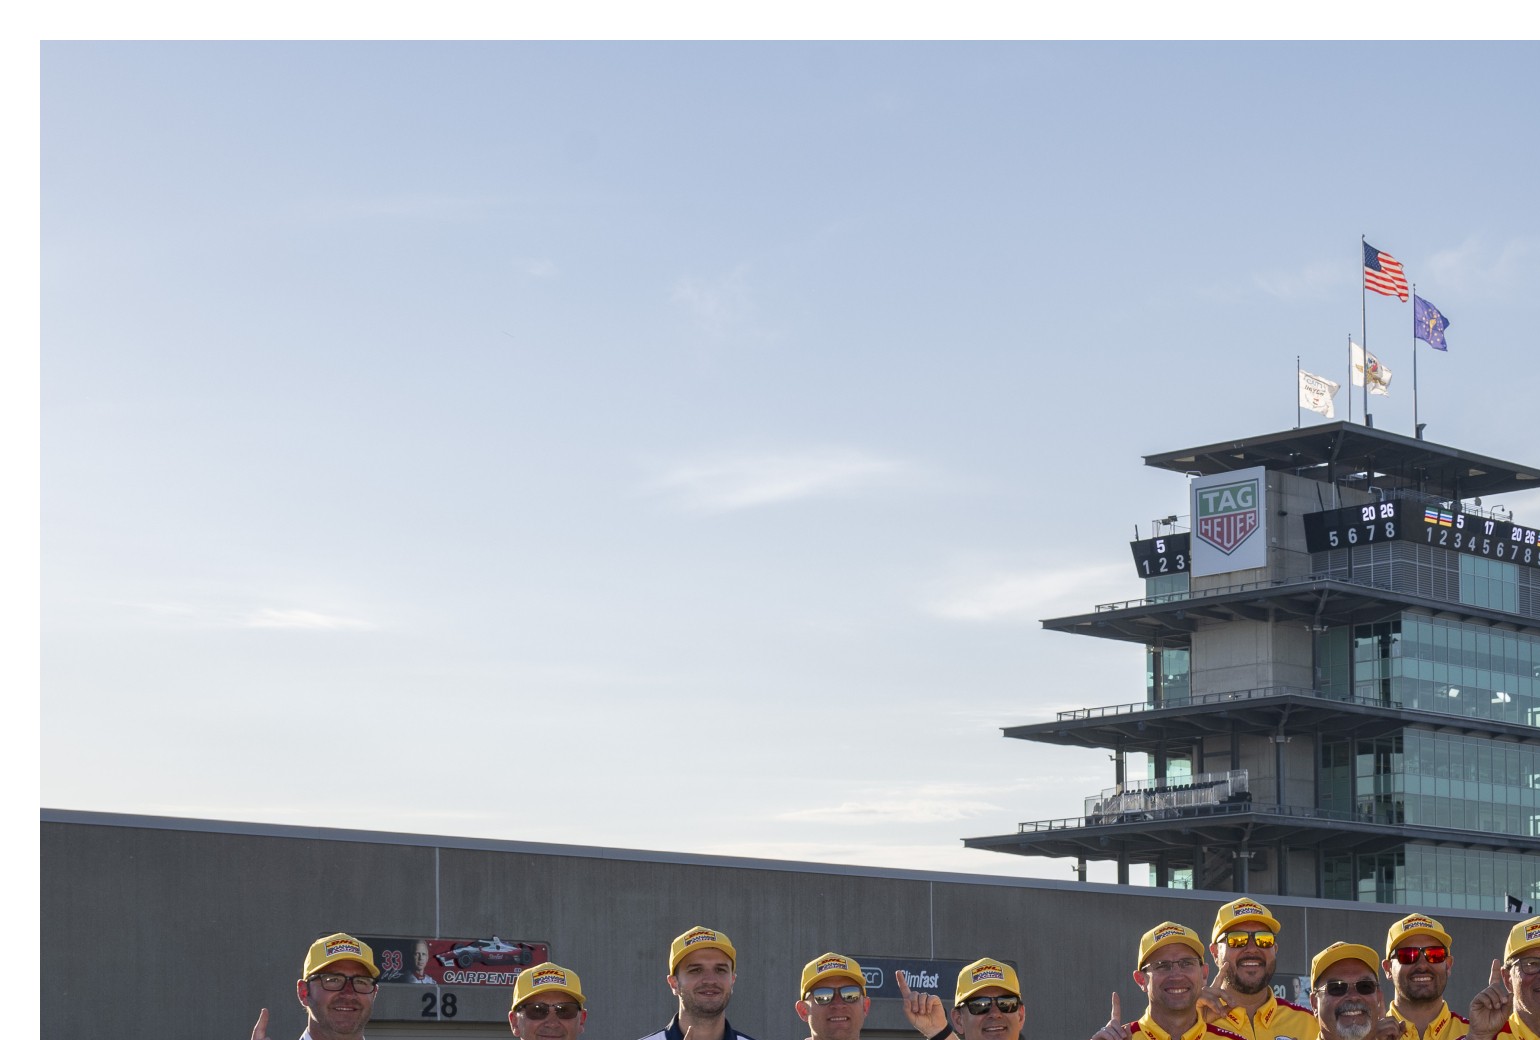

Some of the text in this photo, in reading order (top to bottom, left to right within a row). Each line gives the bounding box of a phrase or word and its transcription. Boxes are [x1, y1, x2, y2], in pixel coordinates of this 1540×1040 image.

[1202, 487, 1253, 513] TAG
[1362, 503, 1394, 522] 20 26
[1201, 513, 1256, 549] HEUER
[1329, 522, 1394, 547] 5 6 7 8
[1456, 514, 1535, 544] 5 17 20 26
[1156, 540, 1166, 554] 5
[1426, 527, 1433, 542] 1
[1439, 530, 1448, 546] 2
[1454, 533, 1462, 548] 3
[1468, 536, 1476, 551] 4
[1482, 539, 1490, 554] 5
[1496, 542, 1504, 557] 6
[1511, 545, 1518, 560] 7
[1524, 548, 1531, 563] 8
[1143, 555, 1185, 574] 1 2 3
[382, 951, 402, 970] 33
[444, 971, 518, 984] CARPENT
[1274, 985, 1286, 999] 20
[422, 992, 458, 1018] 28
